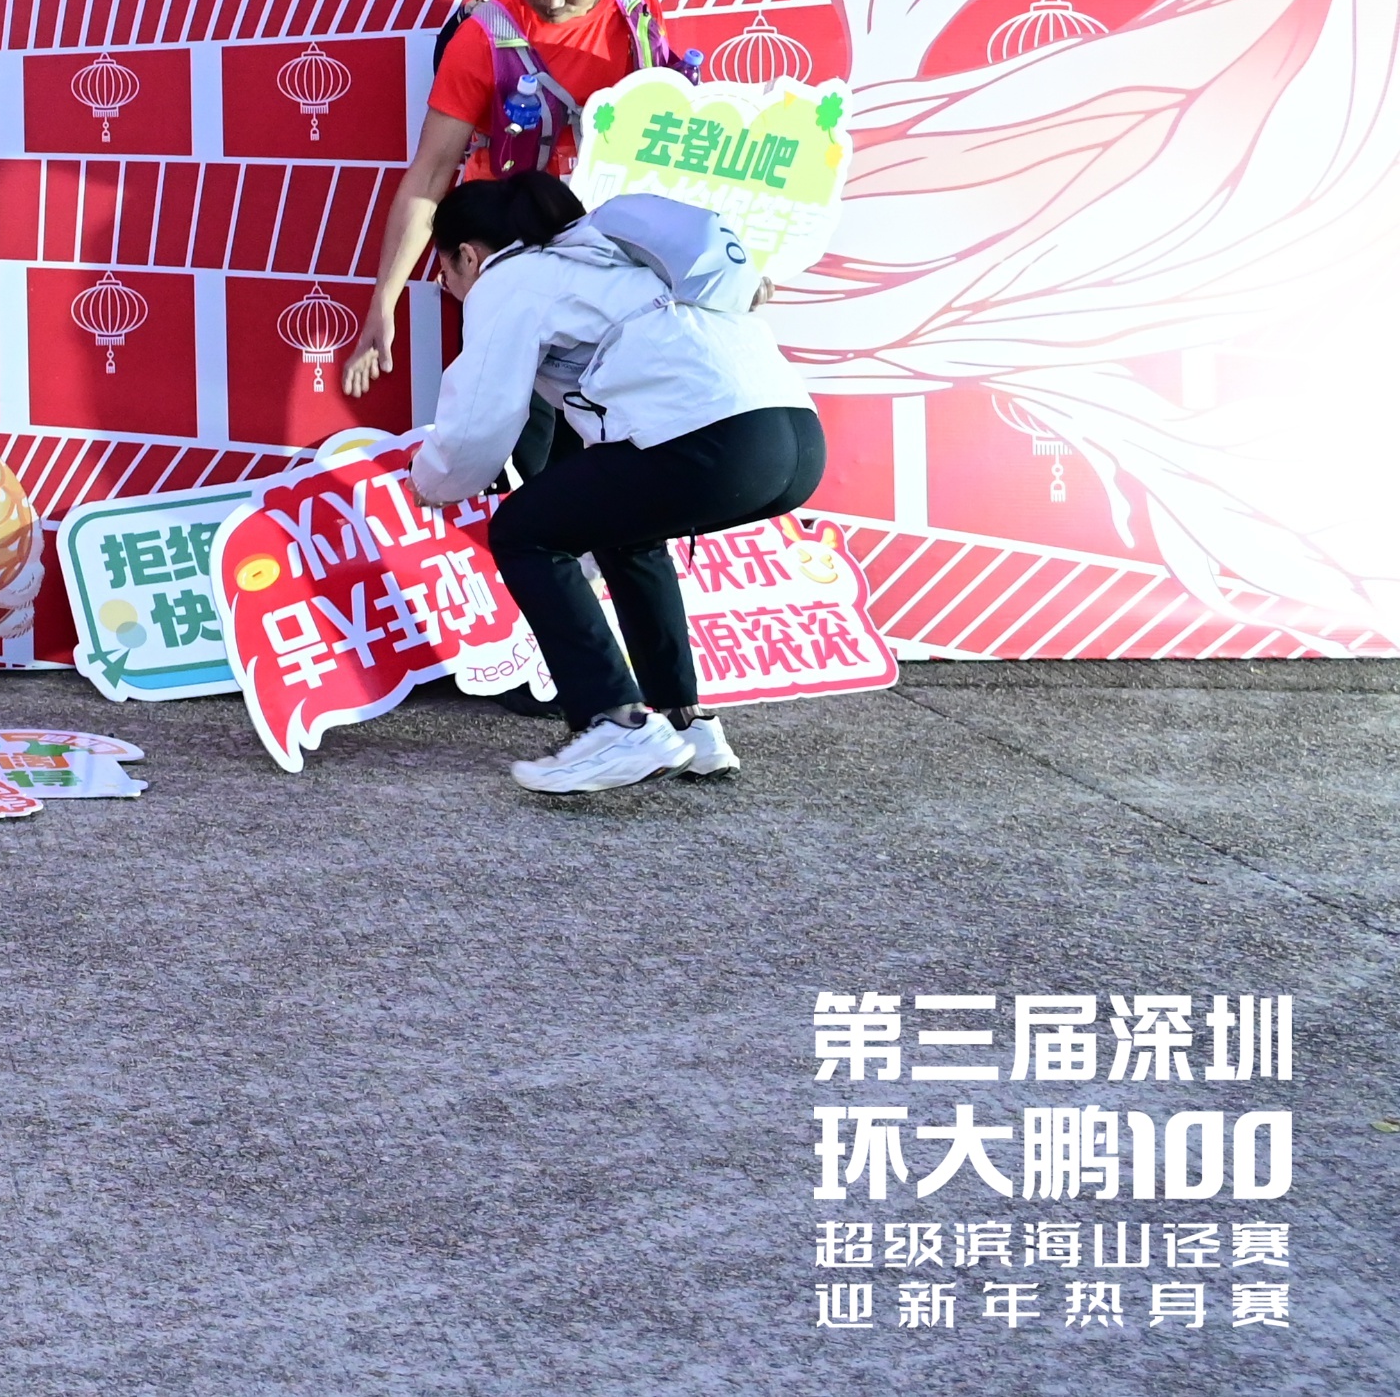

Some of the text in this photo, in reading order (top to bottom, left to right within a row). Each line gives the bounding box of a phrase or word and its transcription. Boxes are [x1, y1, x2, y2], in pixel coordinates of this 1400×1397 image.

[634, 110, 800, 189] 去登山吧
[678, 526, 792, 593] 快乐
[262, 547, 499, 689] 蛇年大吉
[689, 600, 871, 681] 源滚滚
